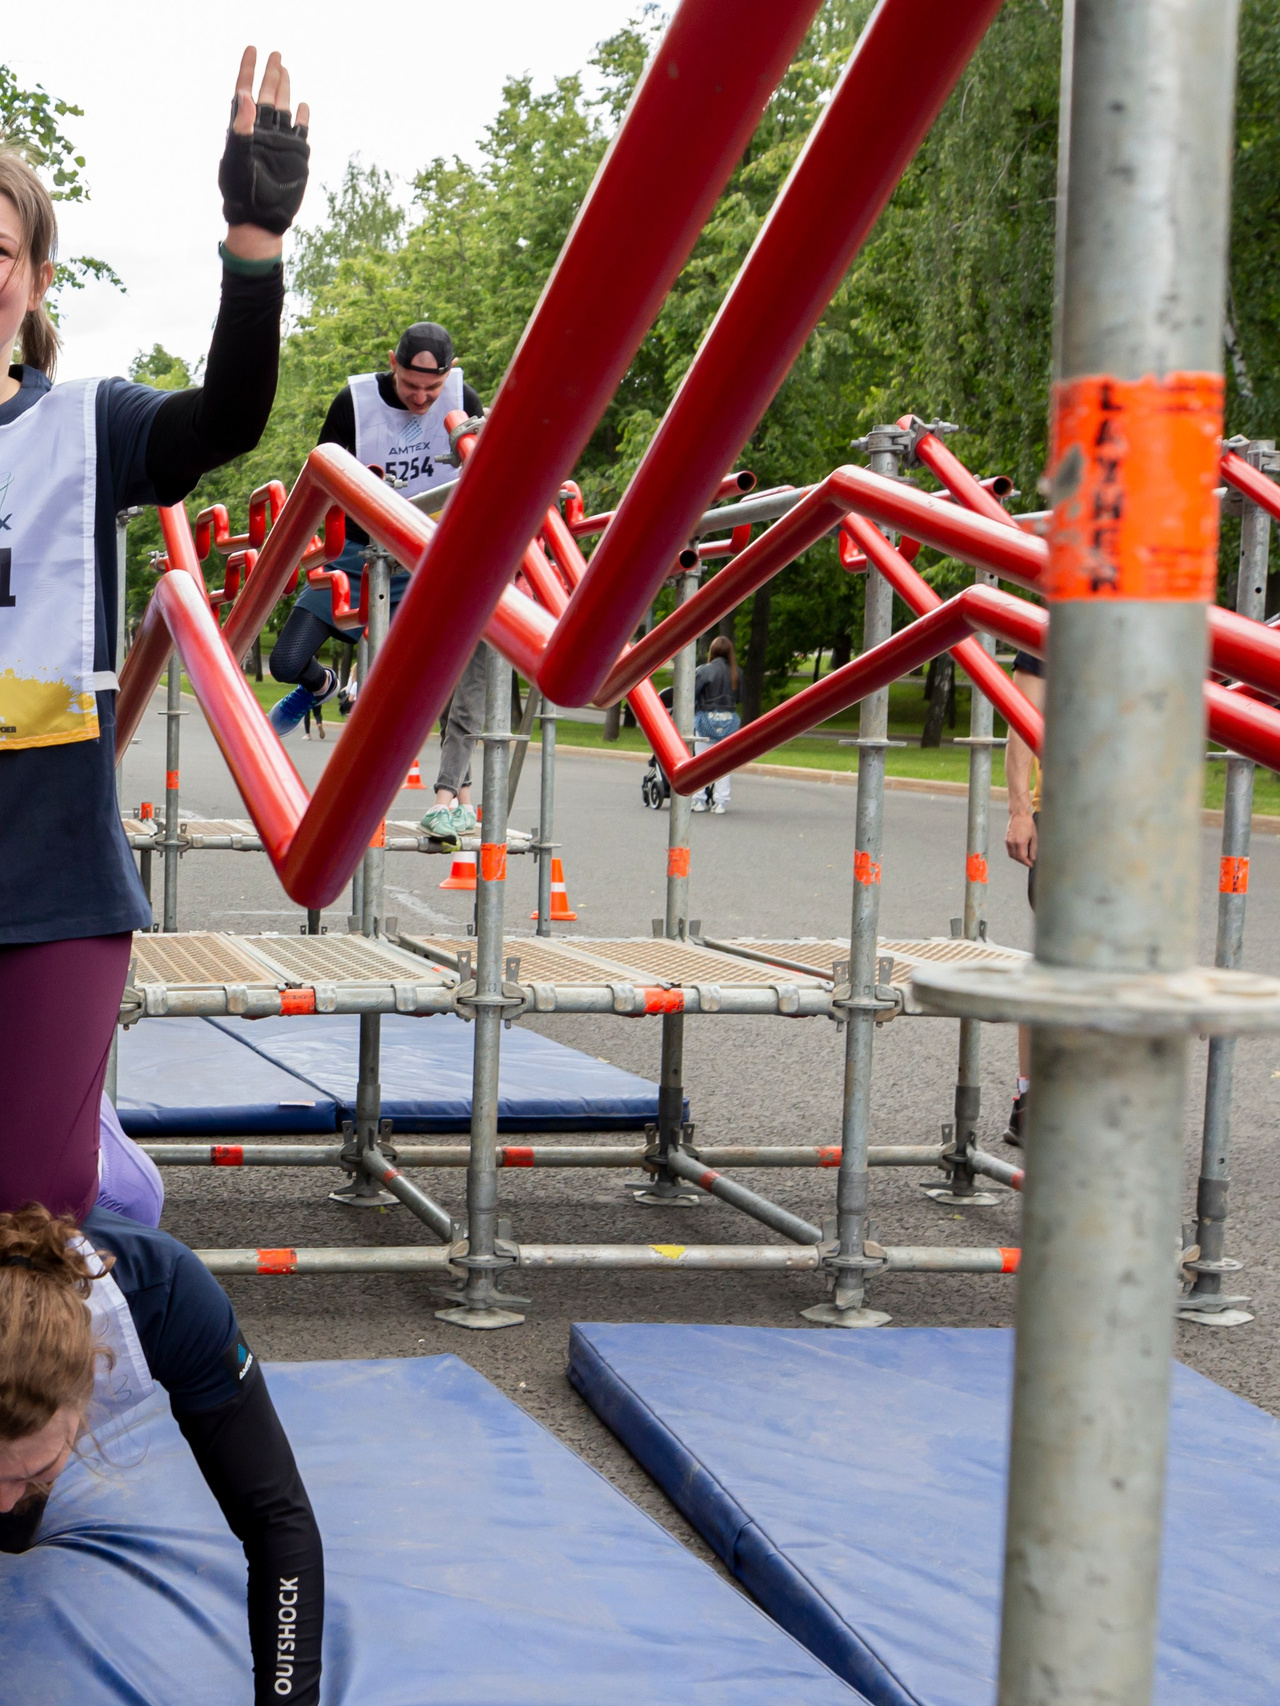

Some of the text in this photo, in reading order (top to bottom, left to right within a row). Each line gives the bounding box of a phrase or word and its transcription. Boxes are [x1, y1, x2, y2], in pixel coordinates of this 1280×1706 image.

[389, 441, 431, 455] AMTEX
[385, 456, 434, 482] 5254
[274, 1576, 299, 1696] OUTSHOCK
